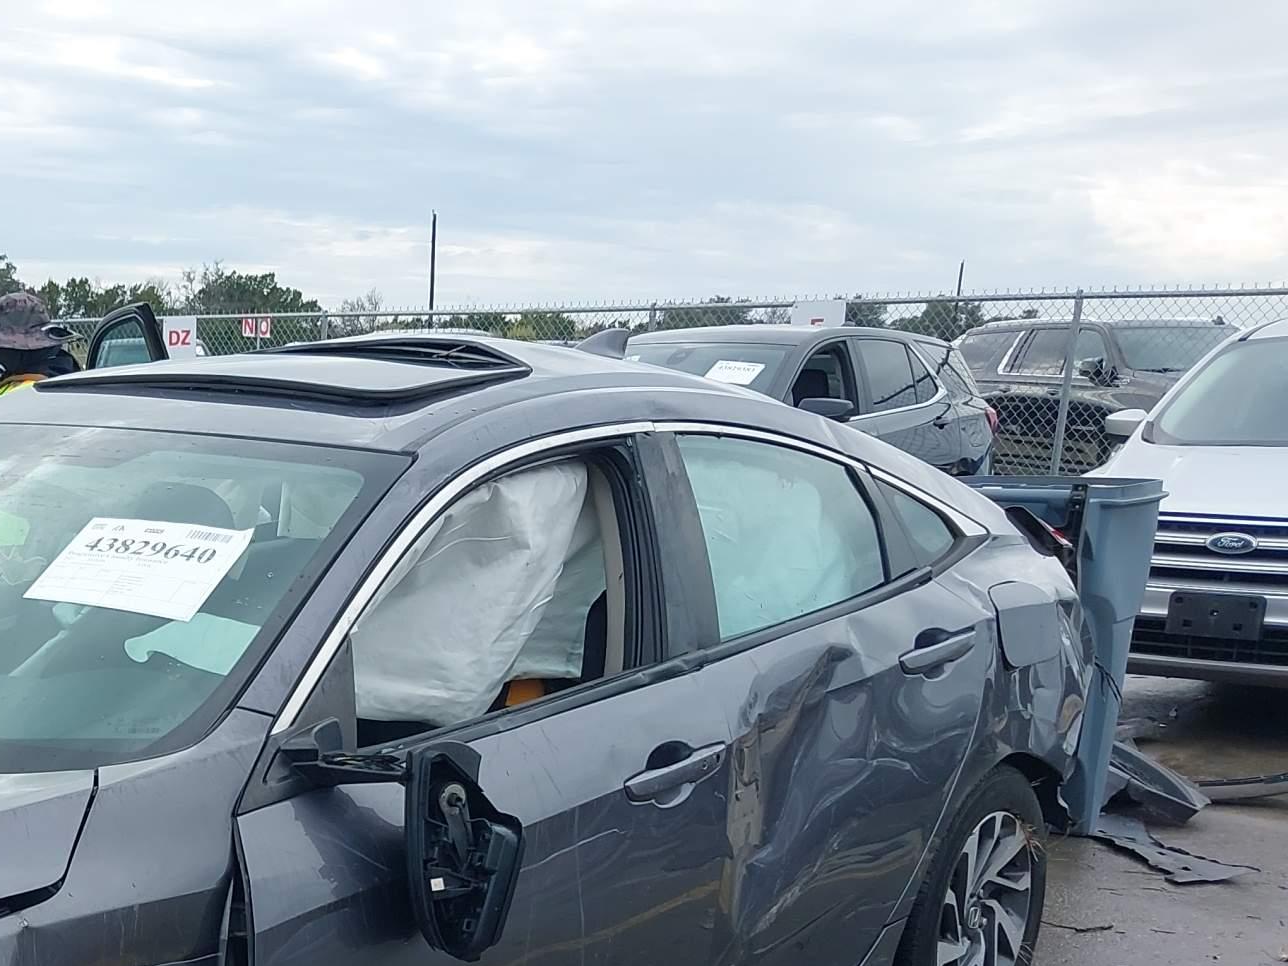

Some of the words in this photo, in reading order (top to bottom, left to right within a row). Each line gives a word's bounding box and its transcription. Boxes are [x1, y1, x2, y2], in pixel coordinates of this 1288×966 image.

[243, 318, 270, 336] NO
[168, 329, 191, 346] DZ
[85, 536, 217, 564] 43829640
[1217, 536, 1245, 548] Ford
